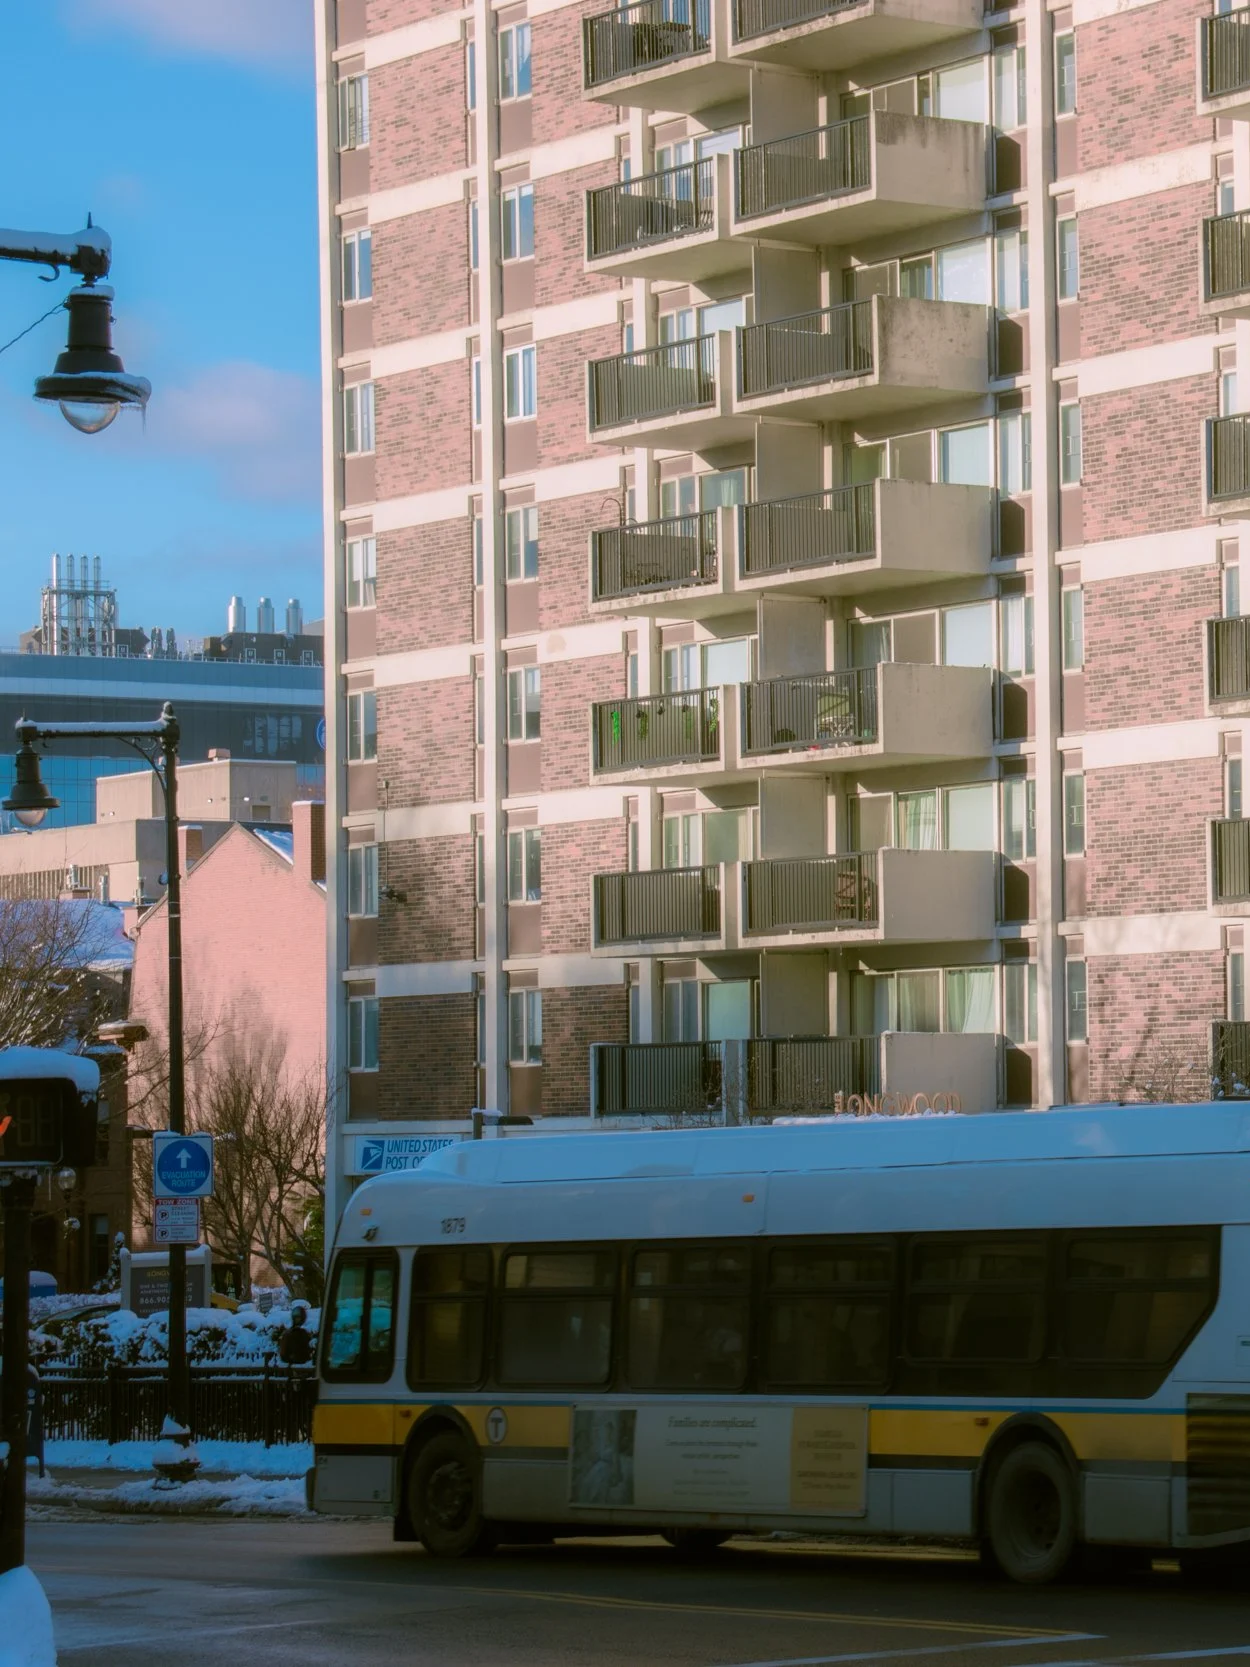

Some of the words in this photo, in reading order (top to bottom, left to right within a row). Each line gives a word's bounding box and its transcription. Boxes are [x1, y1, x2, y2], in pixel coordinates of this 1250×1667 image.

[386, 1139, 421, 1153] UNITED
[385, 1156, 408, 1170] POST
[161, 1170, 207, 1180] EVACUATION
[171, 1179, 197, 1188] ROUTE
[490, 1417, 503, 1439] T
